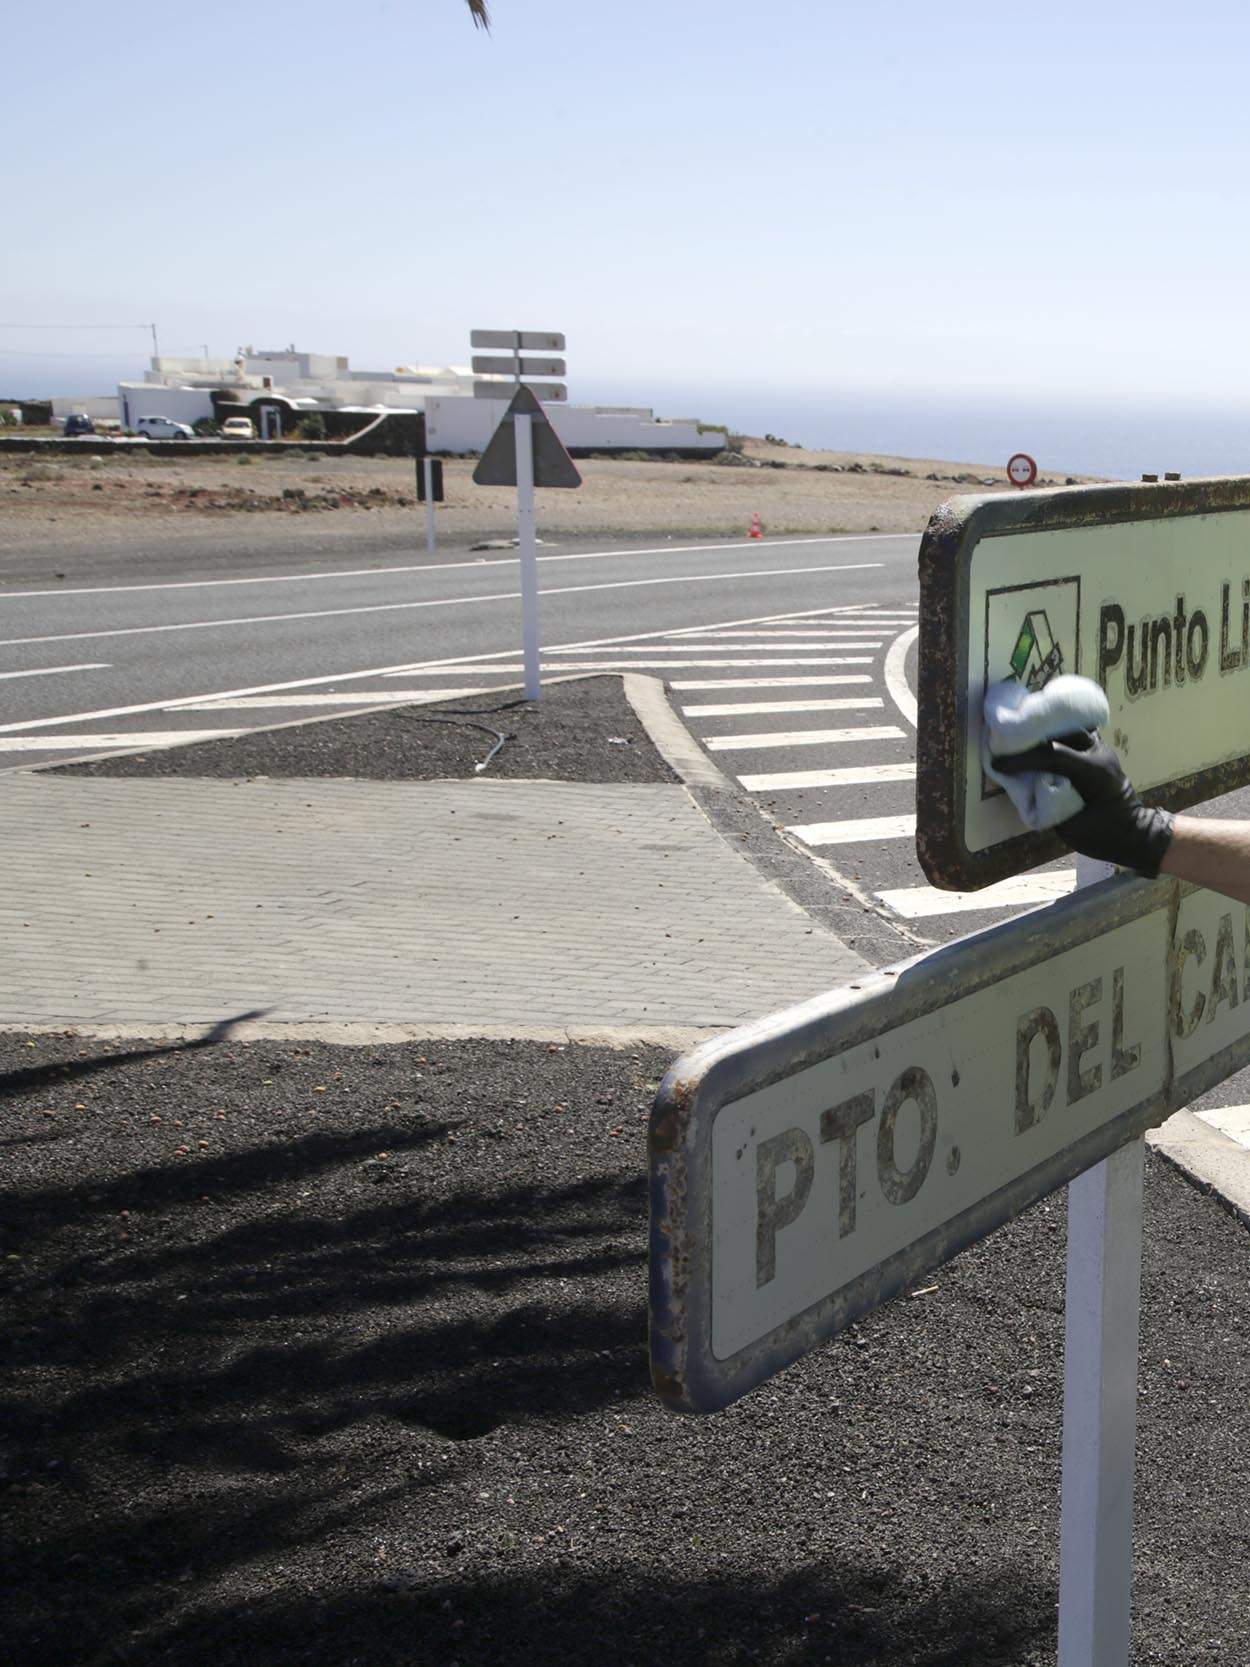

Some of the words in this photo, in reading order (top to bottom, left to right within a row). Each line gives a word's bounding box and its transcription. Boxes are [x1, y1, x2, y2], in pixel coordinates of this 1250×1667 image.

[1099, 597, 1208, 695] Punto
[756, 1066, 960, 1289] PTO.
[1015, 966, 1142, 1136] DEL
